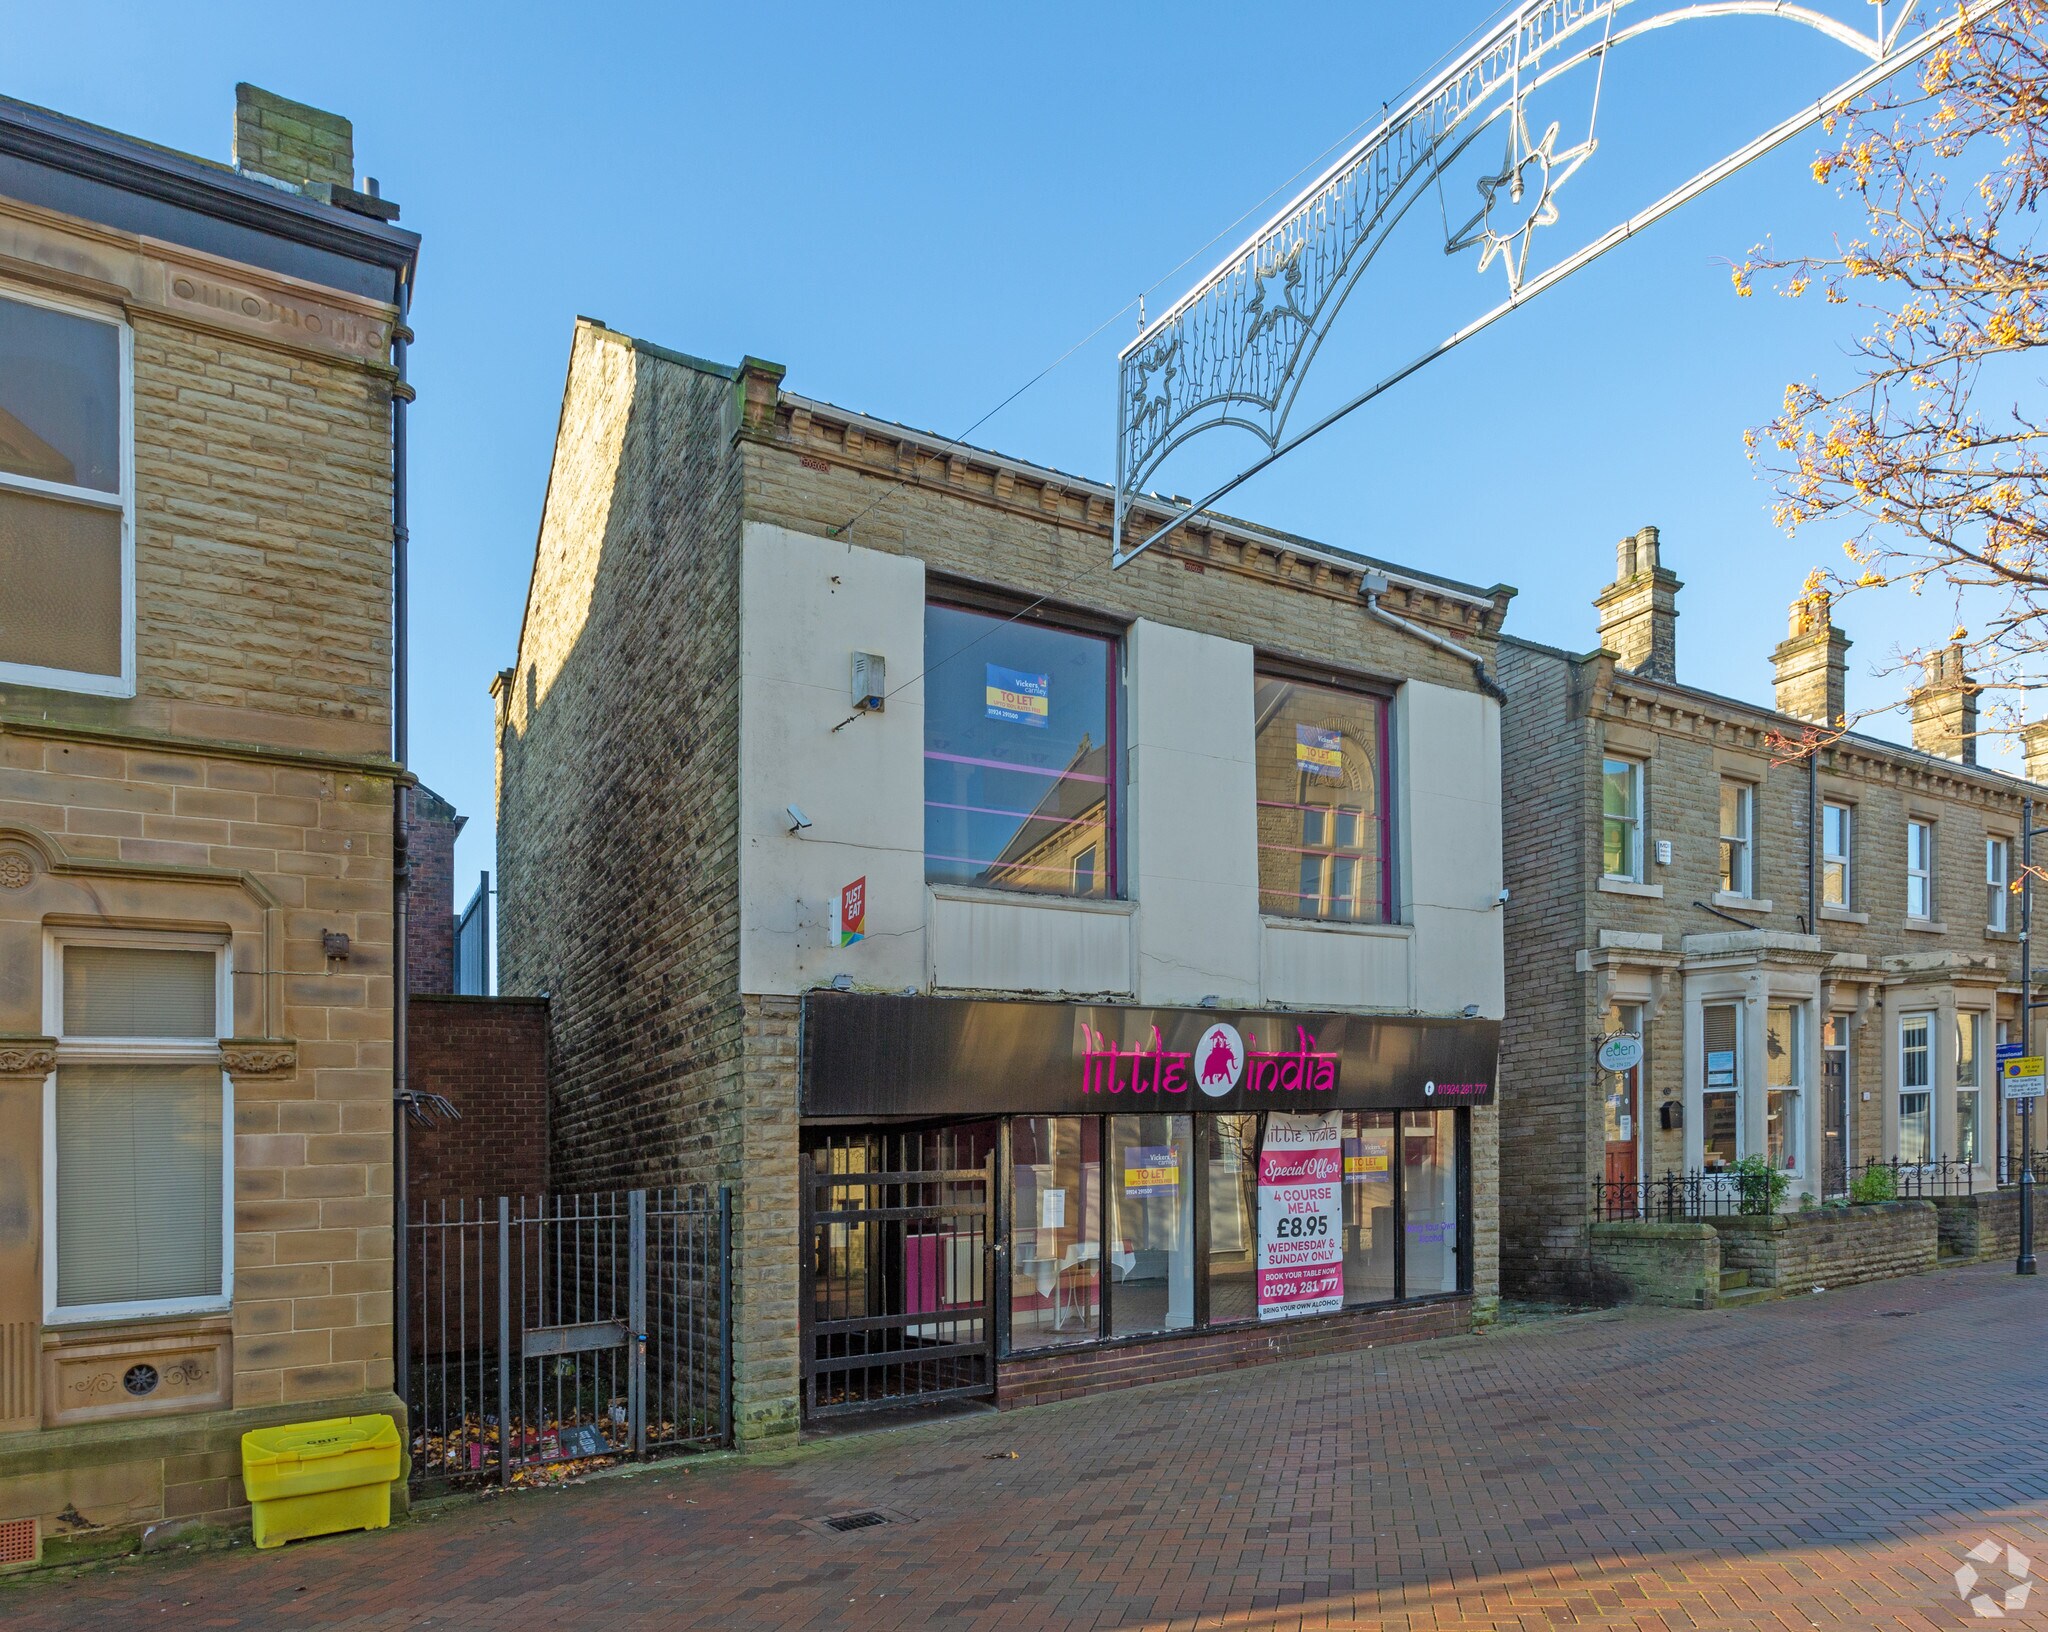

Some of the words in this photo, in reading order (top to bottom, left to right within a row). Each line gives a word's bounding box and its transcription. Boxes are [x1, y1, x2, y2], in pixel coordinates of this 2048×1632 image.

[1015, 679, 1038, 688] Vickers
[1000, 691, 1015, 703] TO
[1017, 695, 1034, 706] LET
[1306, 747, 1316, 756] TO
[1318, 750, 1330, 759] LET
[845, 884, 862, 909] JUST
[848, 900, 862, 920] EAT
[1605, 1042, 1636, 1057] eden
[1081, 1023, 1191, 1094] little
[1246, 1025, 1337, 1092] india
[1437, 1083, 1459, 1095] 01924
[1460, 1083, 1473, 1095] 281
[1474, 1083, 1488, 1095] 777
[1265, 1159, 1308, 1182] Special
[1307, 1157, 1339, 1179] Offer
[1353, 1157, 1364, 1167] TO
[1365, 1157, 1377, 1166] LET
[1136, 1169, 1149, 1179] TO
[1151, 1169, 1166, 1179] LET
[1274, 1190, 1281, 1202] 4
[1283, 1187, 1332, 1202] COURSE
[1288, 1201, 1320, 1214] MEAL
[1277, 1215, 1328, 1238] £8.95
[1441, 1221, 1456, 1230] Own
[1267, 1239, 1326, 1253] WEDNESDAY
[1329, 1238, 1335, 1248] &
[1269, 1252, 1309, 1265] SUNDAY
[1311, 1250, 1334, 1261] ONLY
[1265, 1272, 1284, 1281] BOOK
[1284, 1271, 1302, 1279] YOUR
[1303, 1268, 1321, 1278] TABLE
[1322, 1267, 1336, 1275] NOW
[1263, 1283, 1297, 1298] 01924
[1300, 1280, 1319, 1294] 281
[1320, 1277, 1338, 1291] 777
[1263, 1307, 1280, 1315] BRING
[1296, 1302, 1311, 1310] OWN
[1312, 1299, 1339, 1308] ALCOHOL
